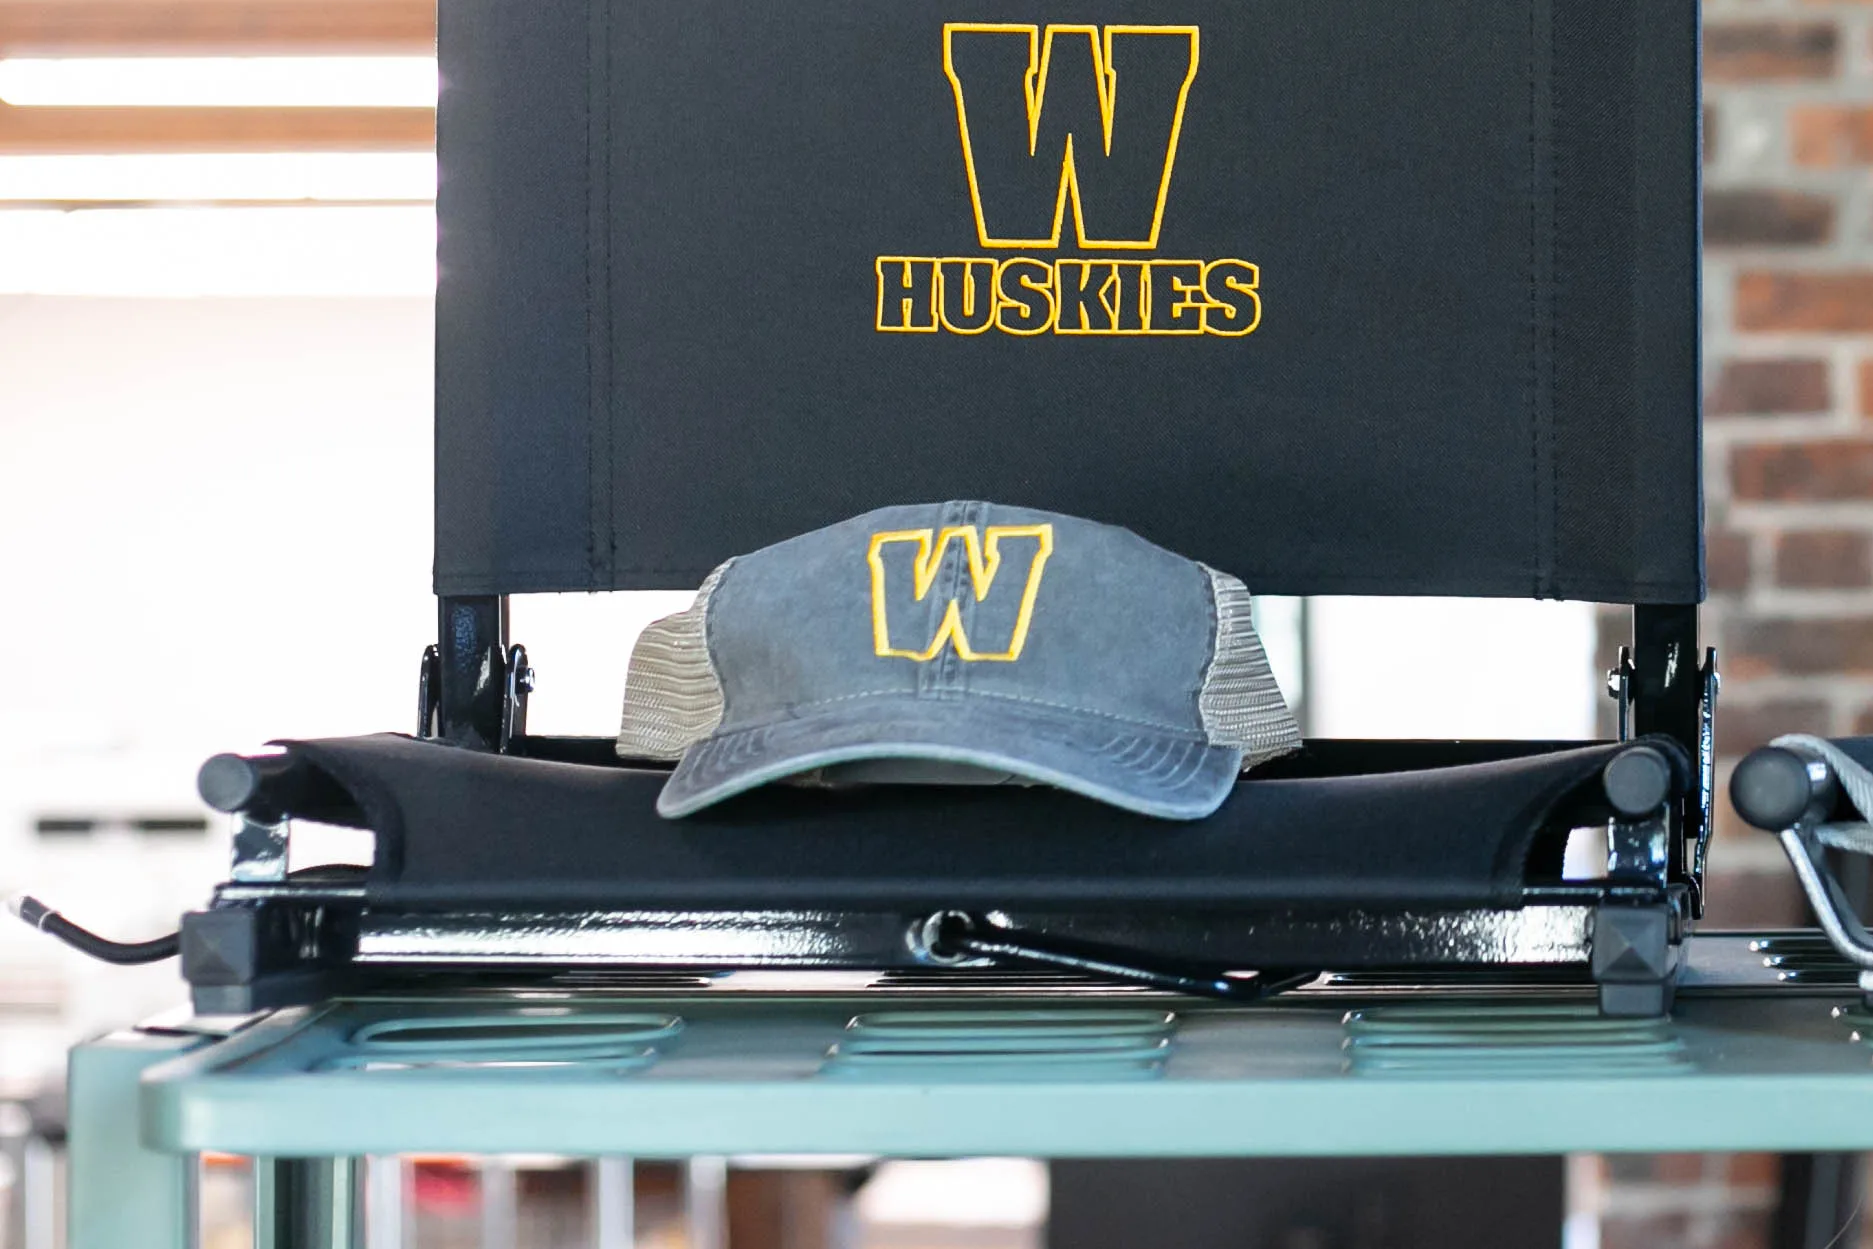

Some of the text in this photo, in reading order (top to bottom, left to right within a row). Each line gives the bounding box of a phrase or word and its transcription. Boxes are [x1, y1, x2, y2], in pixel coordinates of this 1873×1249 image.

[943, 22, 1200, 250] W
[876, 256, 1262, 337] HUSKIES
[867, 523, 1054, 662] W
